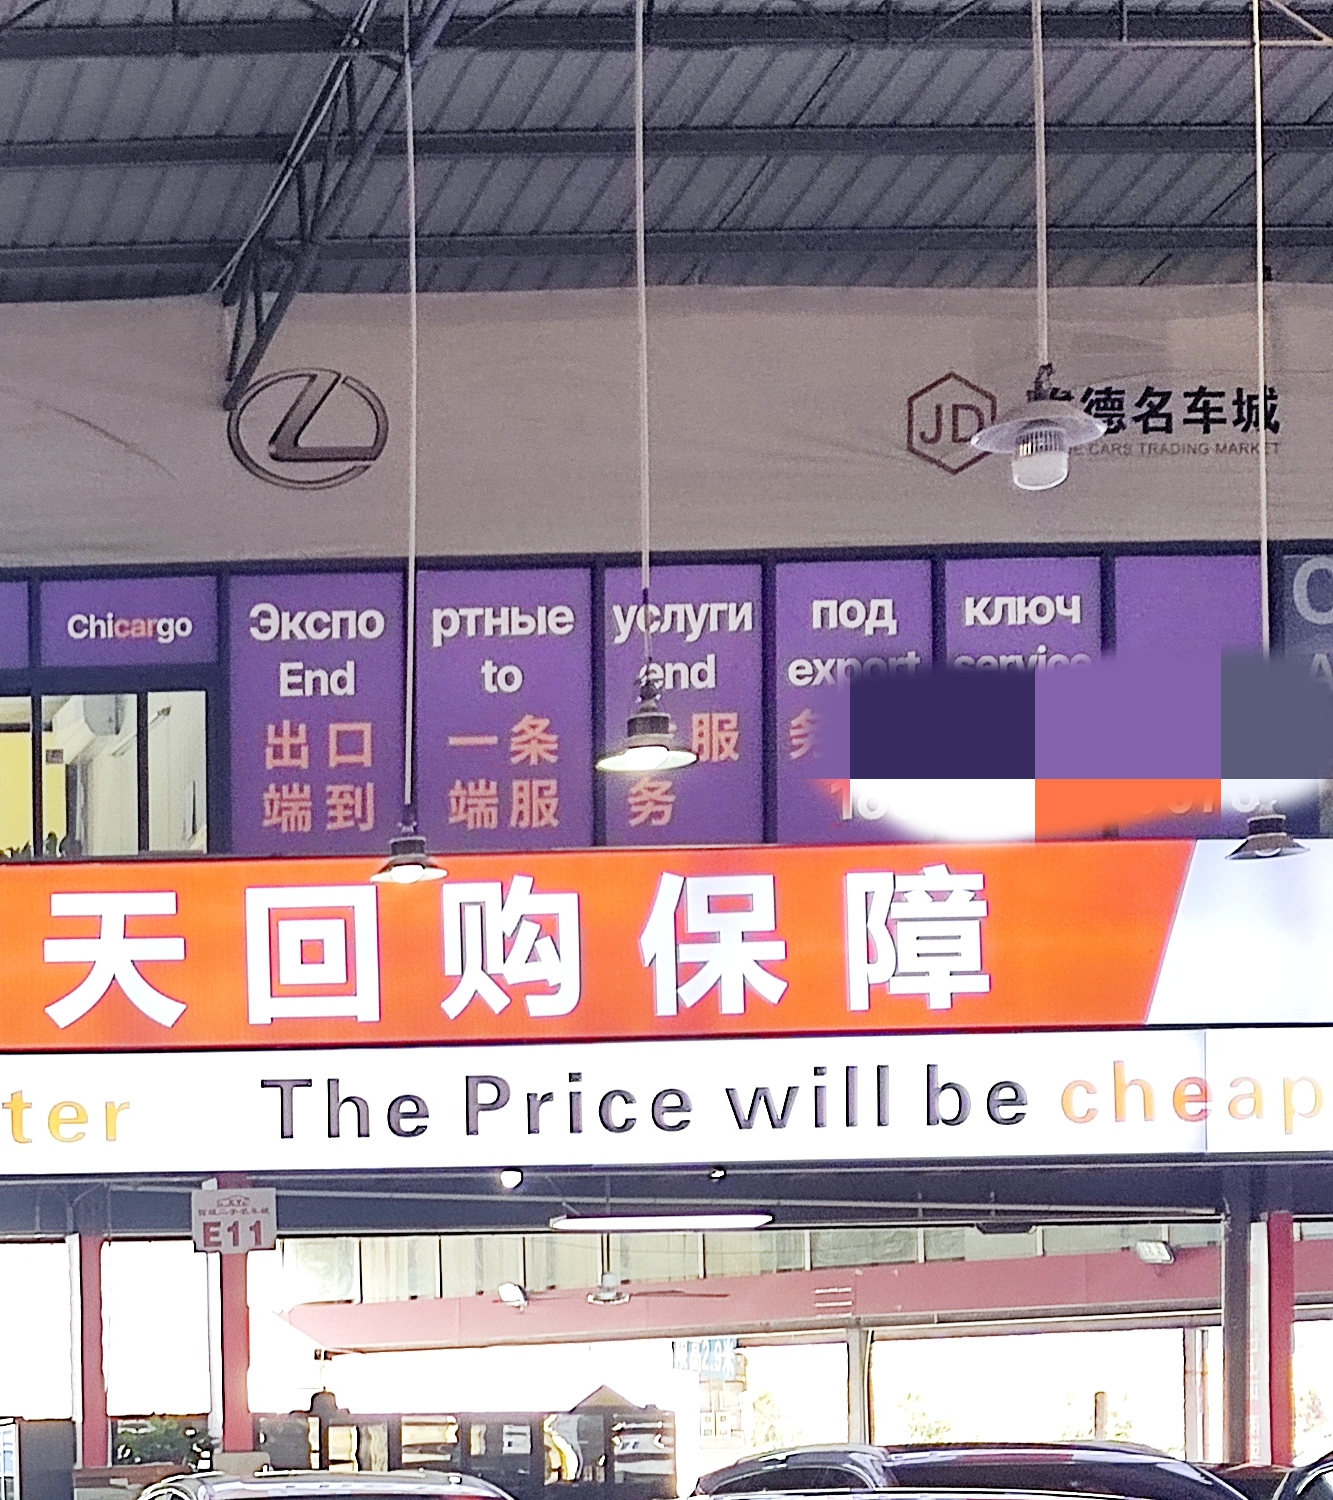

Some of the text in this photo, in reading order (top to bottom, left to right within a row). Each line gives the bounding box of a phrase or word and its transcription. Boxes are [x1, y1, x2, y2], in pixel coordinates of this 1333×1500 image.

[919, 403, 985, 445] JD
[1026, 385, 1281, 435] 德名车城
[1089, 442, 1133, 456] CARS
[1140, 442, 1209, 456] TRADING
[1215, 441, 1281, 456] MARKET
[66, 612, 193, 645] Chicargo
[248, 594, 1082, 648] Экспо ртные услуги под ключ
[279, 659, 357, 699] End
[481, 659, 524, 694] to
[639, 653, 716, 690] end
[260, 1075, 432, 1143] The
[463, 1070, 695, 1137] Price
[725, 1063, 892, 1131] will
[925, 1063, 1029, 1128] be
[1060, 1060, 1325, 1136] cheap
[202, 1220, 263, 1248] E11
